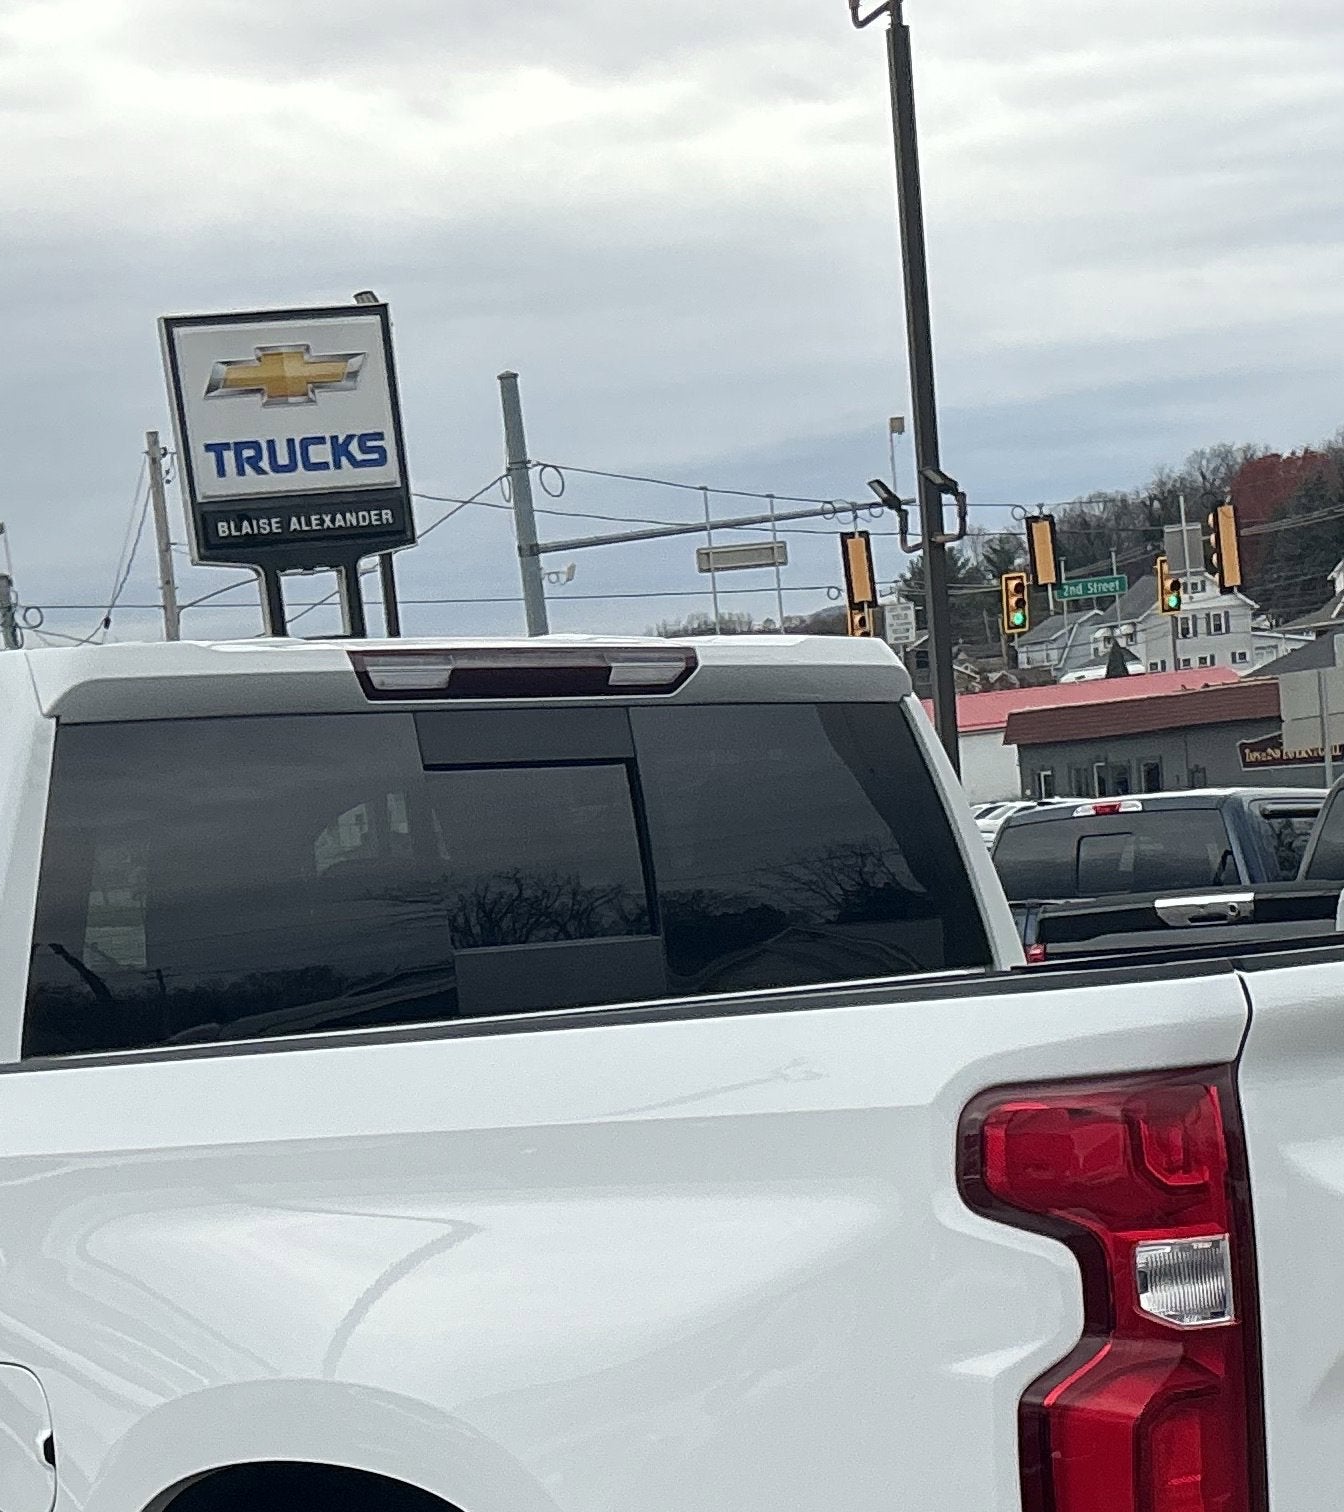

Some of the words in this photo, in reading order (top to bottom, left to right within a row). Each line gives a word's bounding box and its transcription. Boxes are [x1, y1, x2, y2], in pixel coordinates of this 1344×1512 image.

[203, 432, 388, 478] TRUCKS
[217, 516, 283, 537] BLAISE
[289, 509, 394, 532] ALEXANDER
[1063, 583, 1083, 596] 2nd
[1087, 580, 1120, 593] Street
